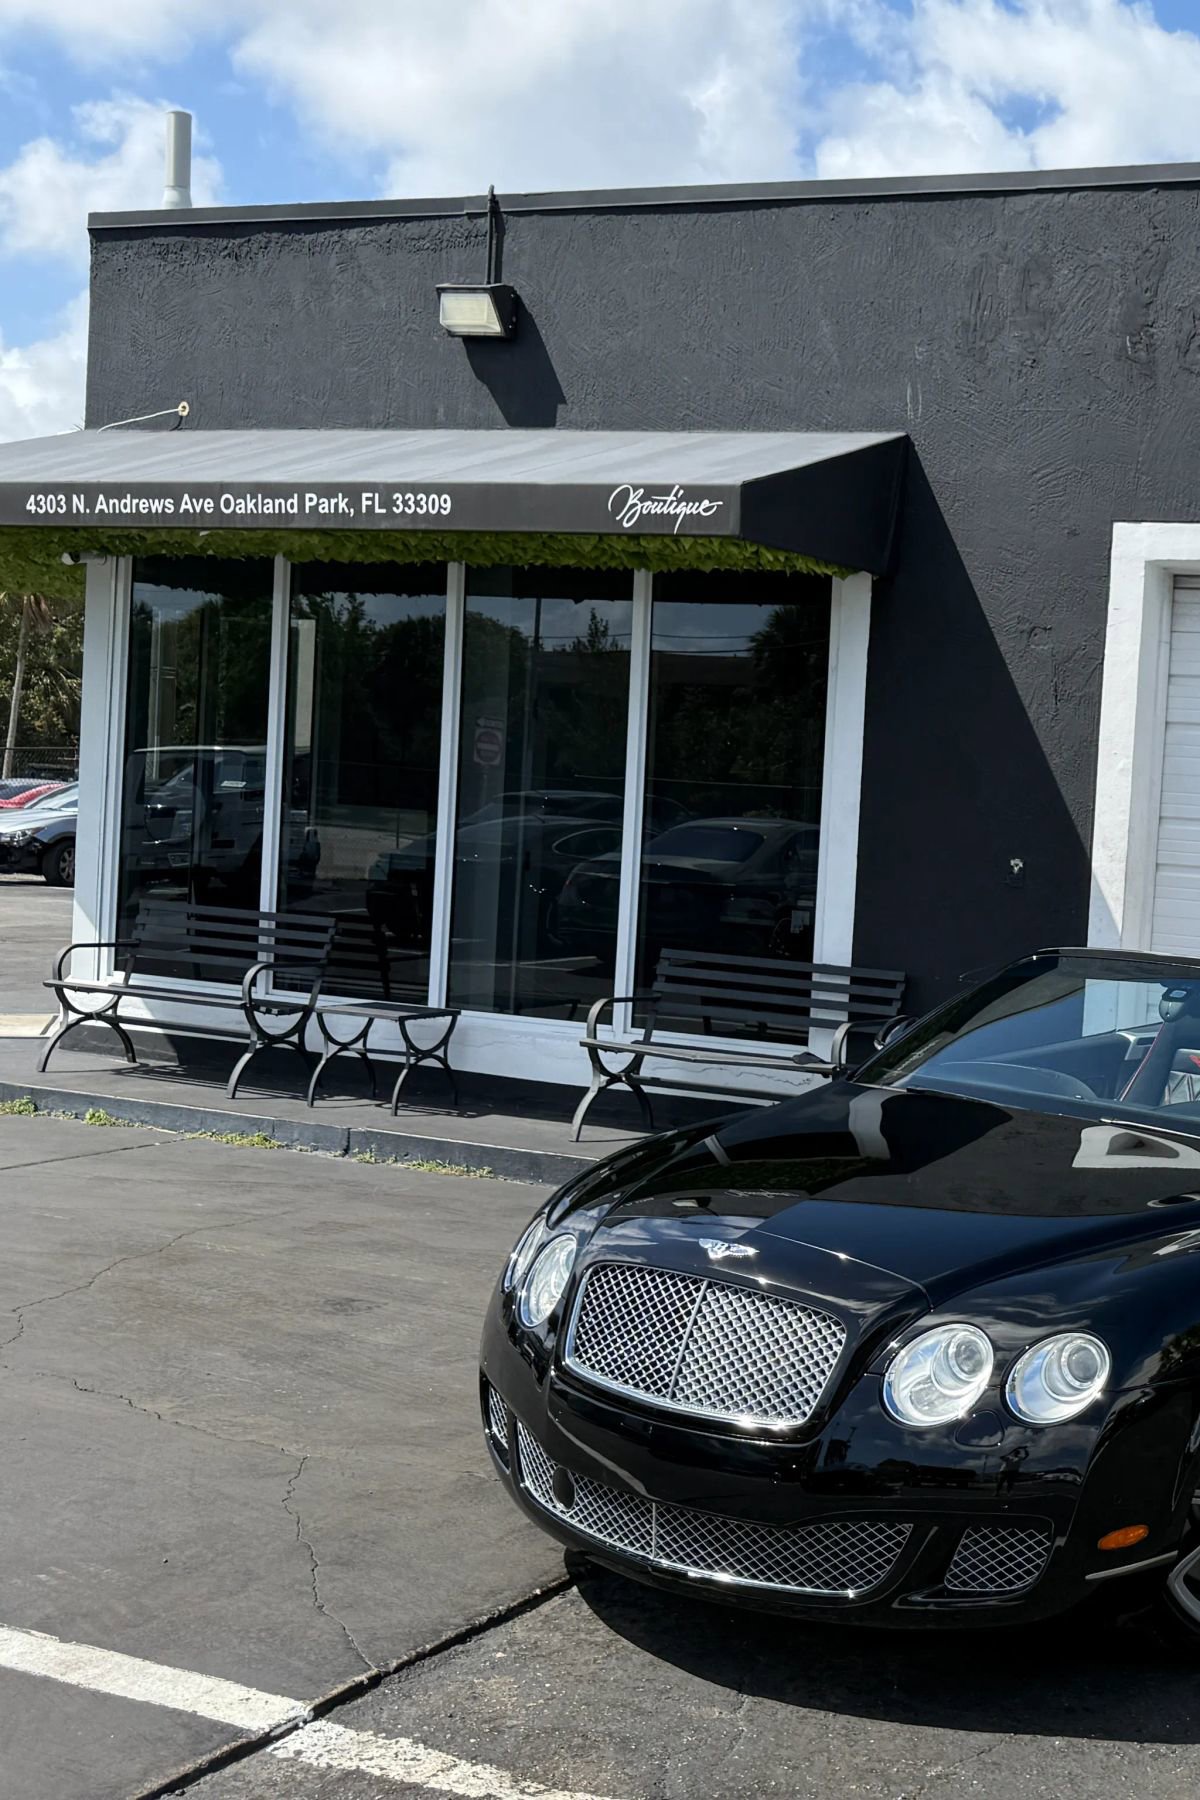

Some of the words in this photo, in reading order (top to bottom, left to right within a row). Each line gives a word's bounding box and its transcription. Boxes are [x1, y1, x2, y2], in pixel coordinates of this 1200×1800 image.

[25, 494, 67, 514] 4303
[72, 493, 90, 514] N.
[95, 493, 175, 514] Andrews
[179, 493, 215, 514] Ave
[219, 493, 298, 514] Oakland
[304, 492, 355, 518] Park,
[361, 492, 387, 514] FL
[392, 492, 452, 516] 33309
[607, 484, 724, 535] Boutique
